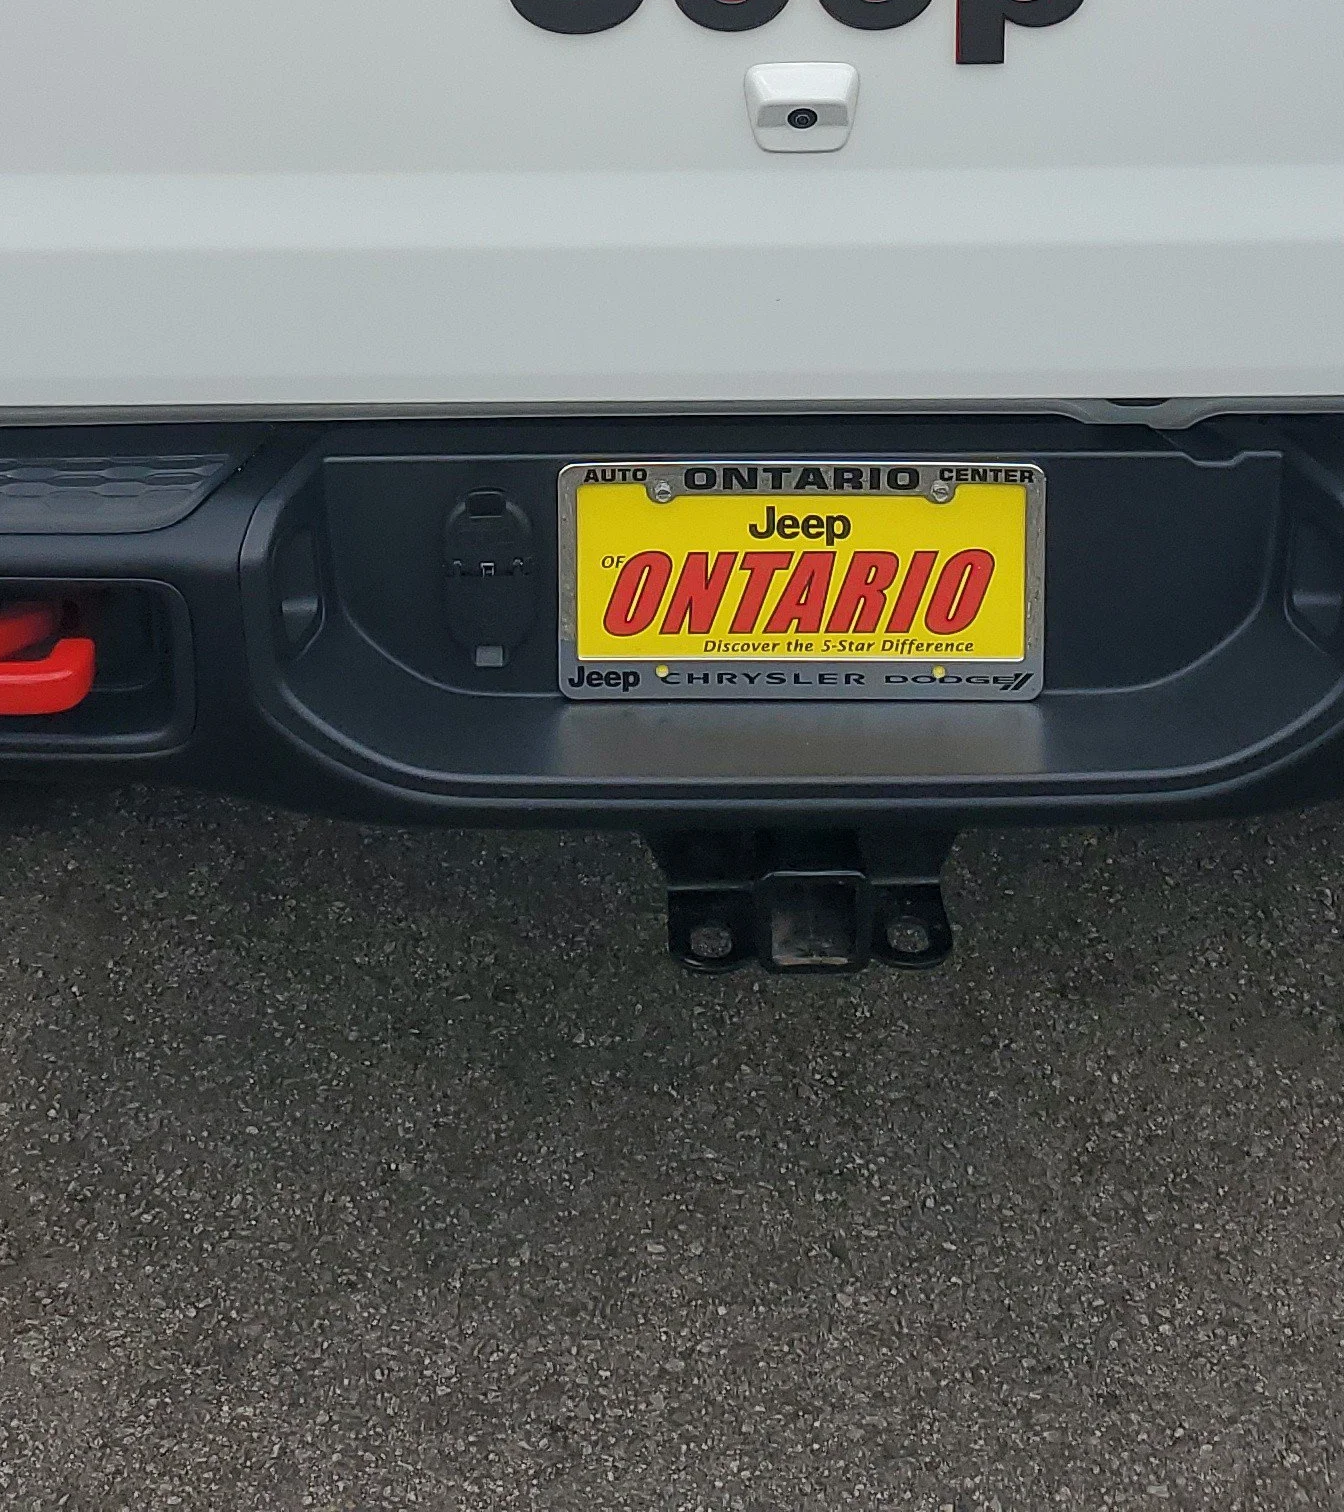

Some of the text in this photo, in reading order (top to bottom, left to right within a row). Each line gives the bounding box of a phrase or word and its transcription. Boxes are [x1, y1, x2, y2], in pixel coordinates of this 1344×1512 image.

[583, 466, 1035, 491] AUTO ONTARIO CENTER
[748, 505, 852, 547] Jeep
[601, 549, 996, 637] OF ONTARIO
[703, 638, 975, 655] Discover the 5-Star Difference
[567, 665, 1017, 692] Jeep CHRYSLER DODGE
